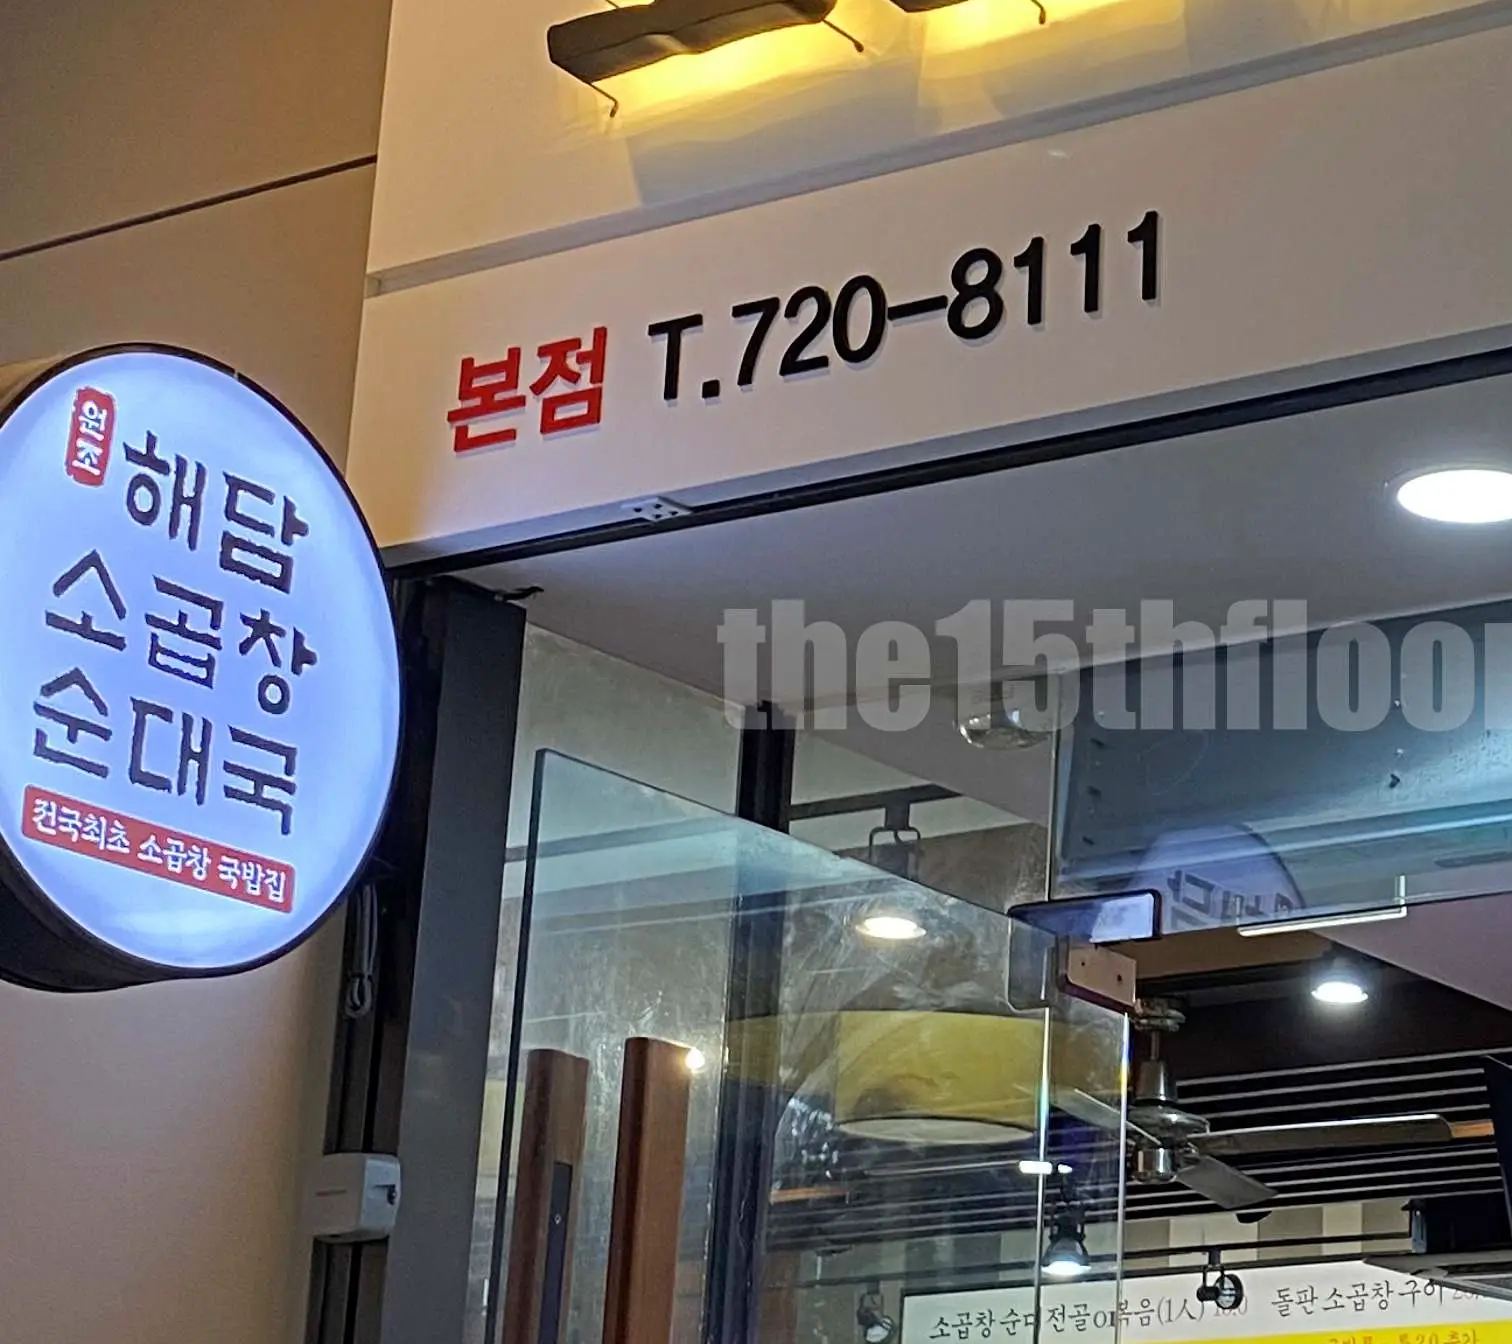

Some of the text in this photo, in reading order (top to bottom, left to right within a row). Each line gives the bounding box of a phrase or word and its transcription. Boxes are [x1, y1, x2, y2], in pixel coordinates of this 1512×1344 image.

[447, 210, 1159, 453] 본점 T.720-8111
[73, 400, 106, 476] 원조
[123, 430, 310, 595] 해담
[45, 549, 318, 716] 소곱창
[33, 667, 299, 836] 순대국
[32, 796, 287, 904] 전국최초 소곱창 국밥집
[929, 1310, 996, 1341] 소곱창
